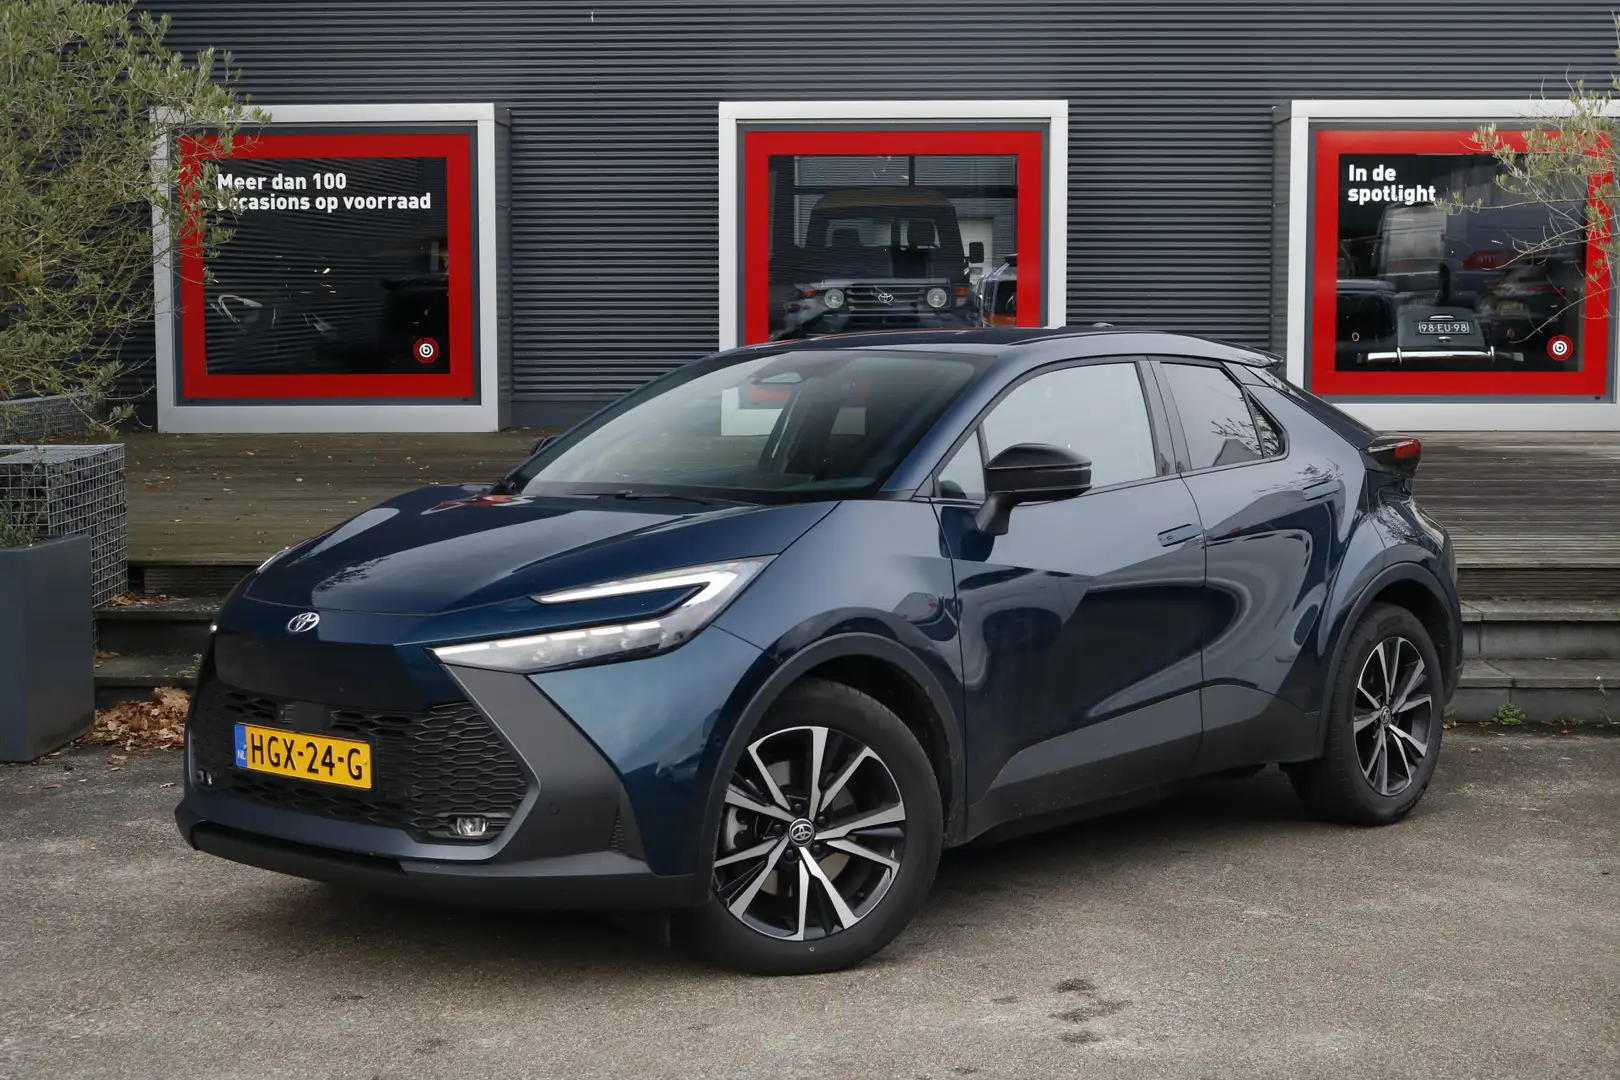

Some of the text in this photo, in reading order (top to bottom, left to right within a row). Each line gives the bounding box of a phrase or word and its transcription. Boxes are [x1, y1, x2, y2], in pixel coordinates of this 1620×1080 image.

[217, 172, 347, 190] Meer dan 100
[1349, 164, 1396, 181] In de
[217, 192, 431, 213] ccasions op voorraad
[1348, 184, 1436, 206] spotlight
[251, 732, 363, 781] HGX-24-G
